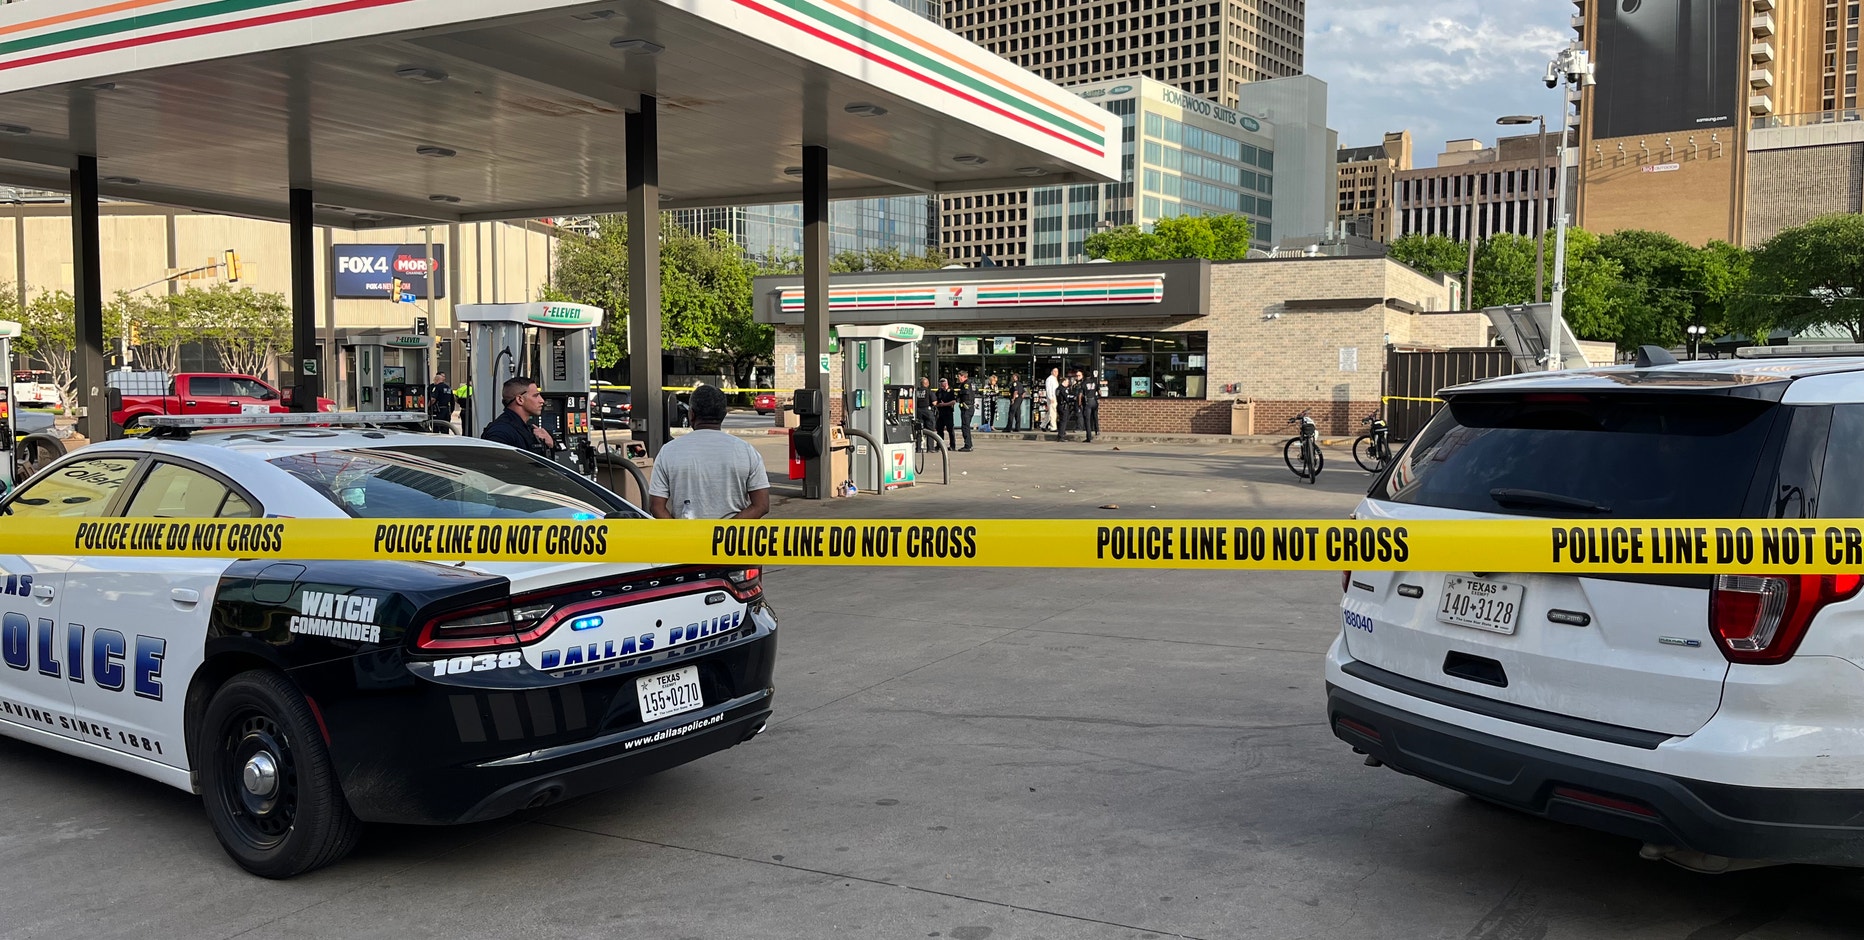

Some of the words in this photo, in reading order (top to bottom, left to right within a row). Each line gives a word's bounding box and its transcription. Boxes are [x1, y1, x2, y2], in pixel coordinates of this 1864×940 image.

[1162, 88, 1211, 116] HOMEWOOD
[1213, 107, 1237, 126] SUITES
[568, 397, 574, 406] 3
[75, 522, 130, 550] POLICE
[130, 523, 166, 550] LINE
[166, 523, 191, 551] DO
[192, 524, 227, 552] NOT
[228, 524, 284, 552] CROSS
[374, 524, 433, 553] POLICE
[436, 525, 475, 554] LINE
[477, 525, 502, 554] DO
[505, 526, 543, 554] NOT
[545, 525, 608, 555] CROSS
[712, 525, 779, 557] POLICE
[783, 526, 824, 557] LINE
[829, 526, 856, 558] DO
[861, 526, 902, 558] NOT
[906, 526, 976, 558] CROSS
[1096, 526, 1174, 560] POLICE
[1180, 527, 1228, 561] LINE
[1233, 527, 1266, 562] DO
[1272, 527, 1320, 562] NOT
[1326, 527, 1409, 562] CROSS
[1551, 527, 1644, 564] POLICE
[1650, 527, 1708, 564] LINE
[1714, 527, 1755, 565] DO
[1761, 527, 1816, 565] NOT
[0, 574, 33, 597] AS
[1467, 581, 1497, 594] TEXAS
[301, 590, 378, 623] WATCH
[1344, 609, 1373, 633] 188040
[289, 616, 381, 644] COMMANDER
[541, 633, 655, 669] DALLAS
[669, 611, 741, 646] POLICE
[2, 612, 167, 702] OLICE
[433, 652, 522, 677] 1038
[656, 673, 681, 686] TEXAS
[59, 715, 113, 741] SINCE
[118, 731, 163, 755] 1881
[624, 712, 725, 750] www.dallaspolice.net
